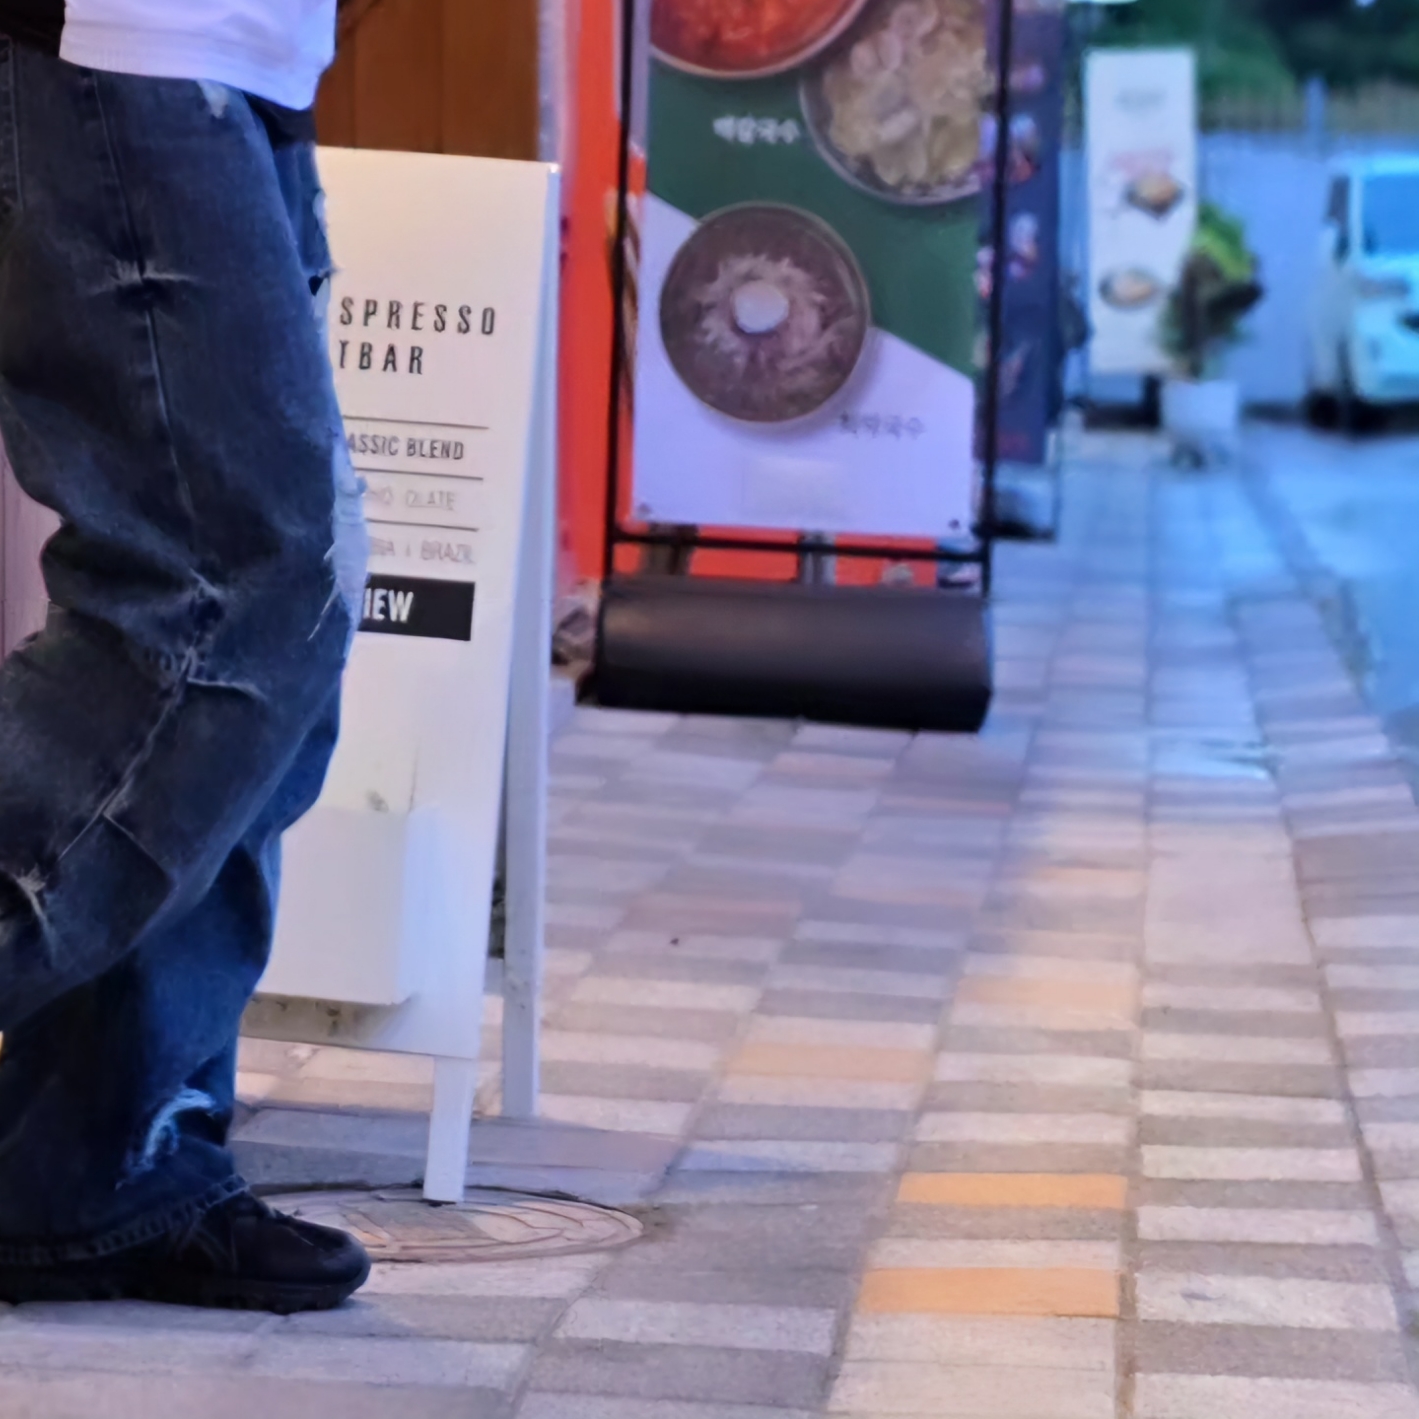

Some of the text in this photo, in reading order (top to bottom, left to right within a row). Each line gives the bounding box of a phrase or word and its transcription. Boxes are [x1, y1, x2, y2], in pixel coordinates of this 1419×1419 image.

[338, 295, 497, 337] SPRESSO
[337, 338, 425, 376] TBAR
[346, 432, 465, 462] ASSIC BLEND
